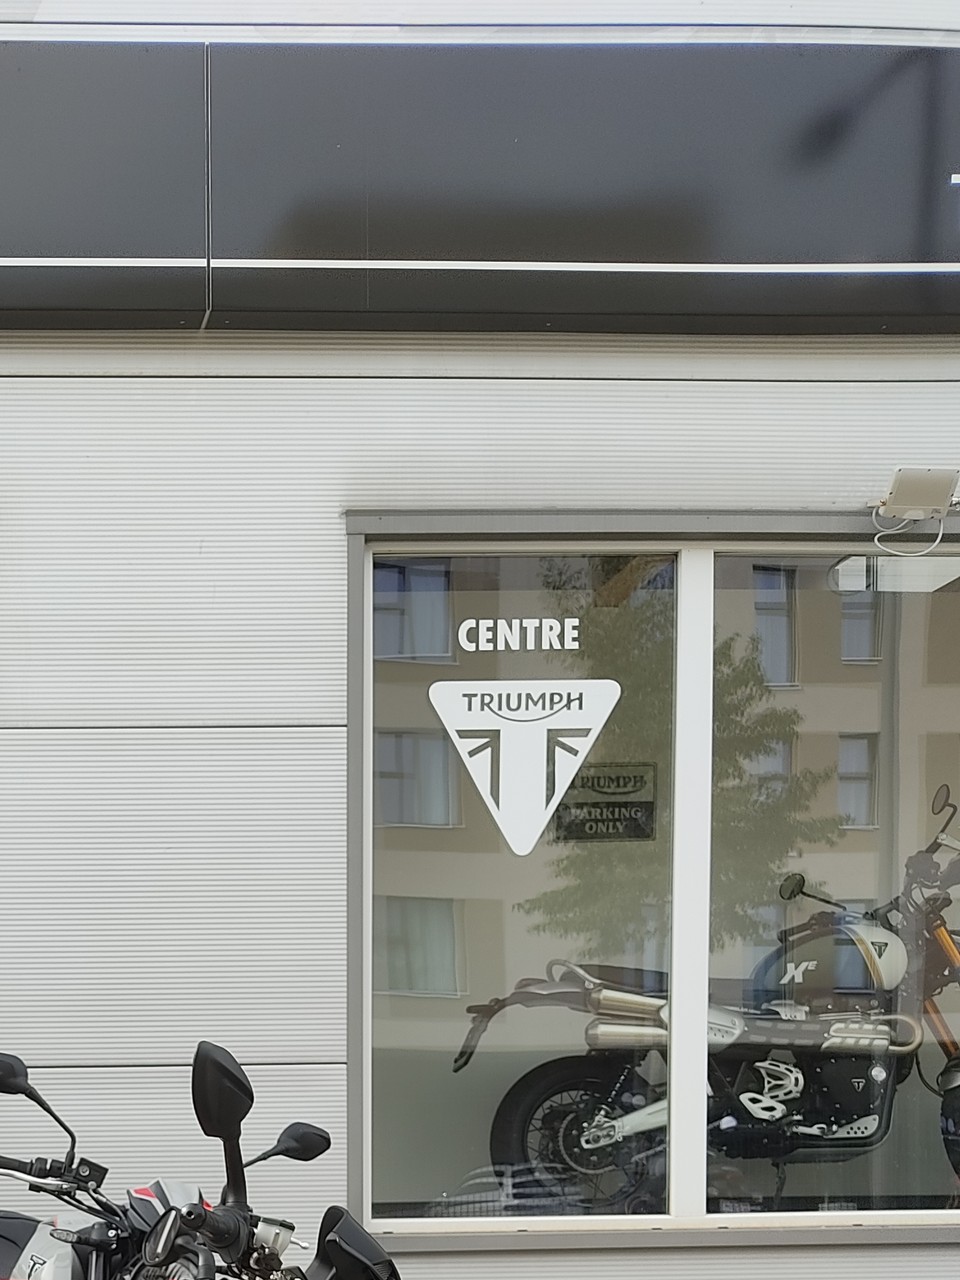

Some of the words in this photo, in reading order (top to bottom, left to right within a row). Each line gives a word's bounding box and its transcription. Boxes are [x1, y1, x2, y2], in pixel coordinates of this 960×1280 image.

[458, 618, 580, 652] CENTRE
[462, 692, 584, 720] TRIUMPH
[571, 807, 641, 821] PARKING
[585, 822, 627, 834] ONLY
